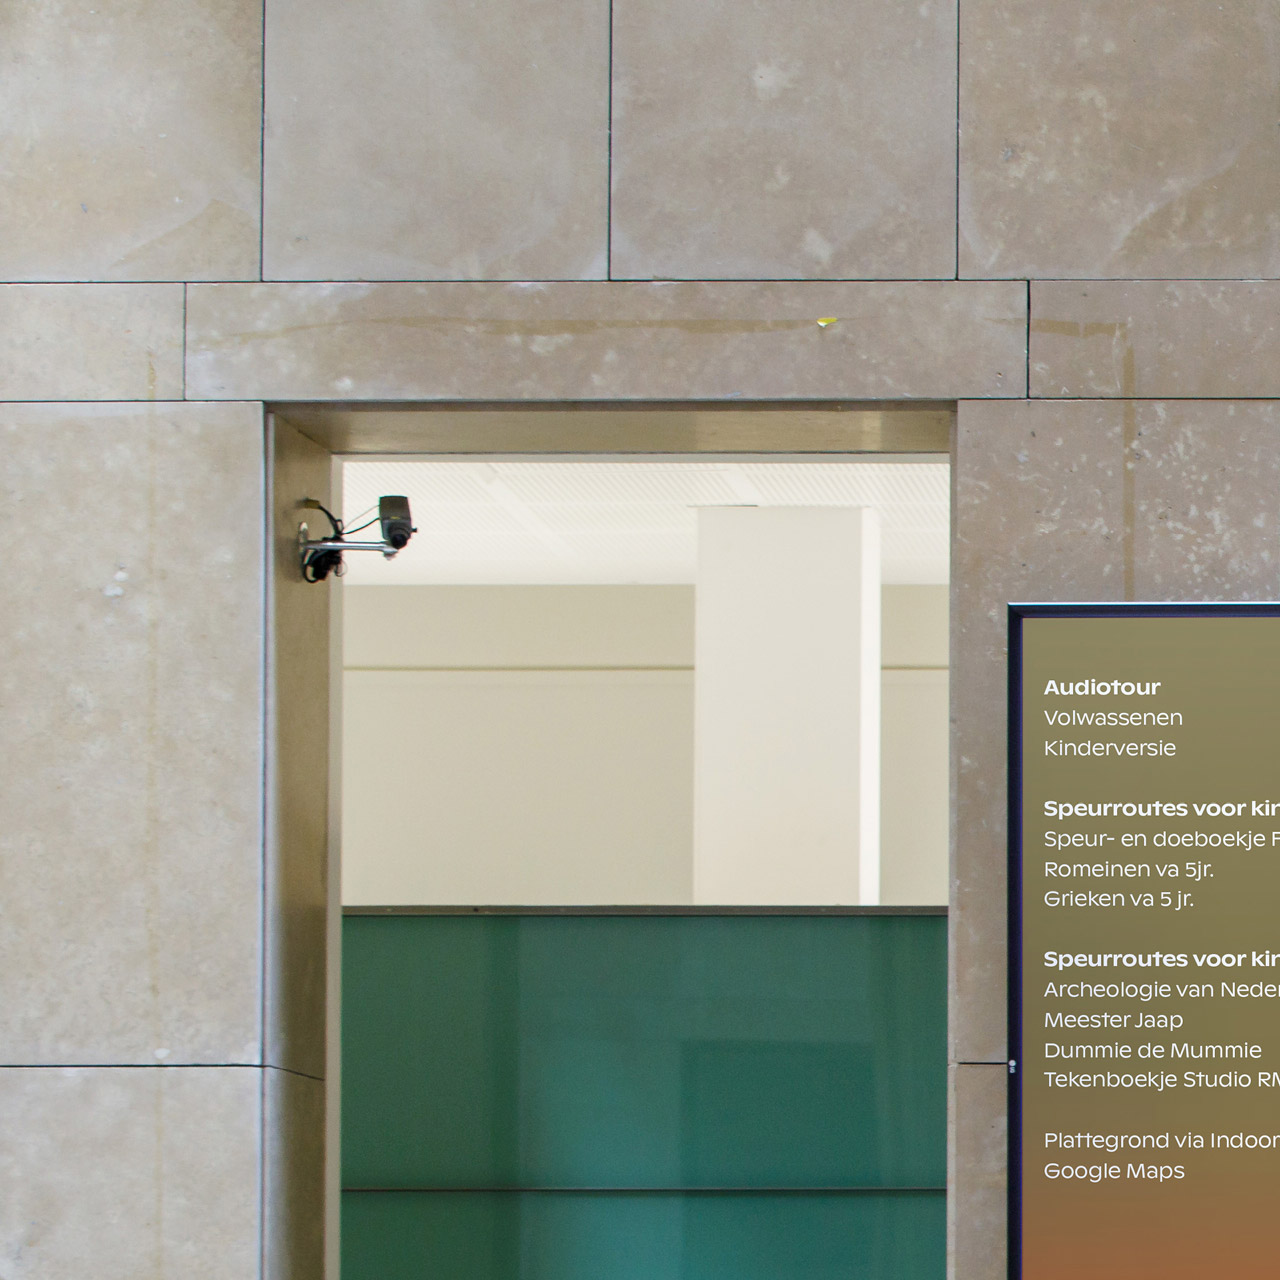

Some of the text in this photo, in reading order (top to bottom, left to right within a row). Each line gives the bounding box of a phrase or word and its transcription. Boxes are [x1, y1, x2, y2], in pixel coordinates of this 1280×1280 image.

[1043, 678, 1162, 696] Audiotour
[1043, 709, 1184, 727] Volwassenen
[1043, 739, 1177, 757] Kinderversie
[1043, 799, 1189, 821] Speurroutes
[1192, 802, 1248, 818] voor
[1044, 830, 1116, 852] Speur-
[1120, 833, 1148, 848] en
[1152, 830, 1267, 852] doeboekje
[1044, 860, 1215, 882] Romeinen va 5jr.
[1043, 890, 1195, 911] Grieken va 5 jr.
[1043, 950, 1189, 972] Speurroutes
[1192, 952, 1248, 968] voor
[1043, 980, 1173, 1002] Archeologie
[1175, 983, 1215, 998] van
[1044, 1011, 1185, 1033] Meester Jaap
[1044, 1041, 1263, 1059] Dummie de Mummie
[1043, 1070, 1179, 1092] Tekenboekje
[1183, 1070, 1253, 1088] Studio
[1044, 1131, 1171, 1153] Plattegrond
[1174, 1131, 1206, 1149] via
[1043, 1162, 1186, 1184] Google Maps
